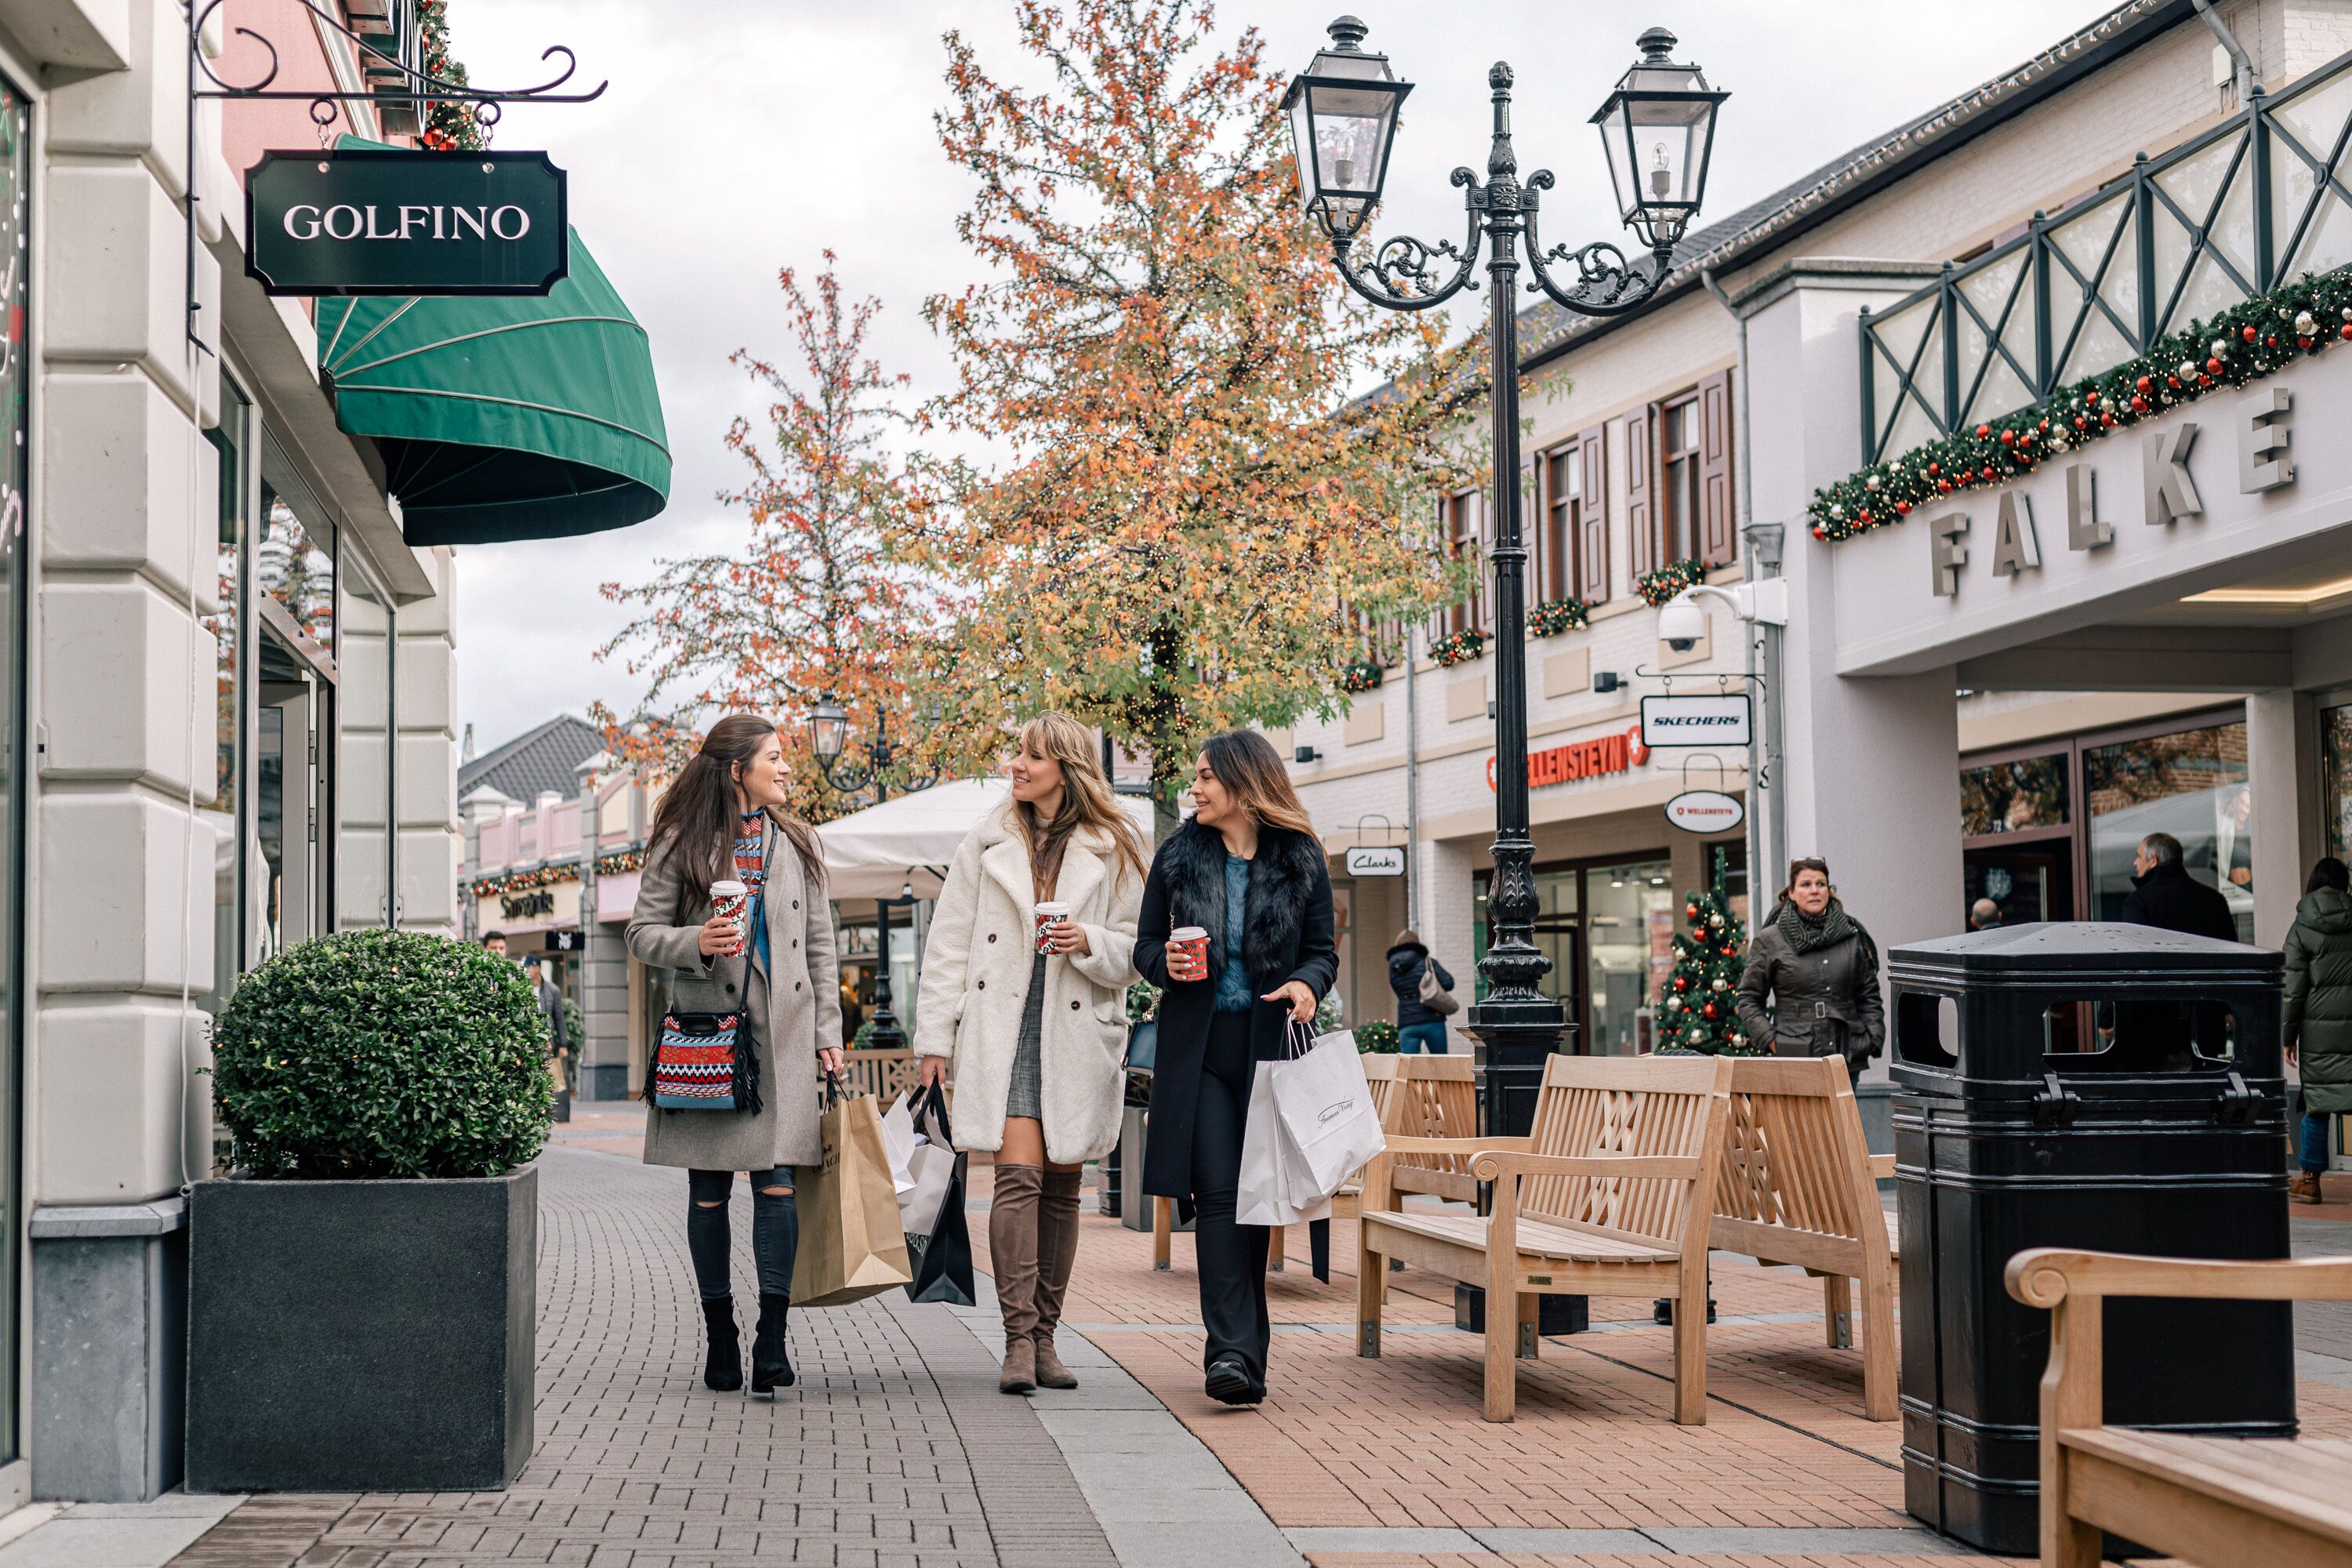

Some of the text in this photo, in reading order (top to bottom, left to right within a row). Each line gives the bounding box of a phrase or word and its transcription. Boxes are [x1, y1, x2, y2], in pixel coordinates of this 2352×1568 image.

[283, 204, 530, 240] GOLFINO
[1930, 387, 2294, 597] FALKE
[1653, 715, 1741, 726] SKECHERS
[1527, 734, 1628, 788] LLENSTEYN
[1353, 855, 1396, 868] Clarks
